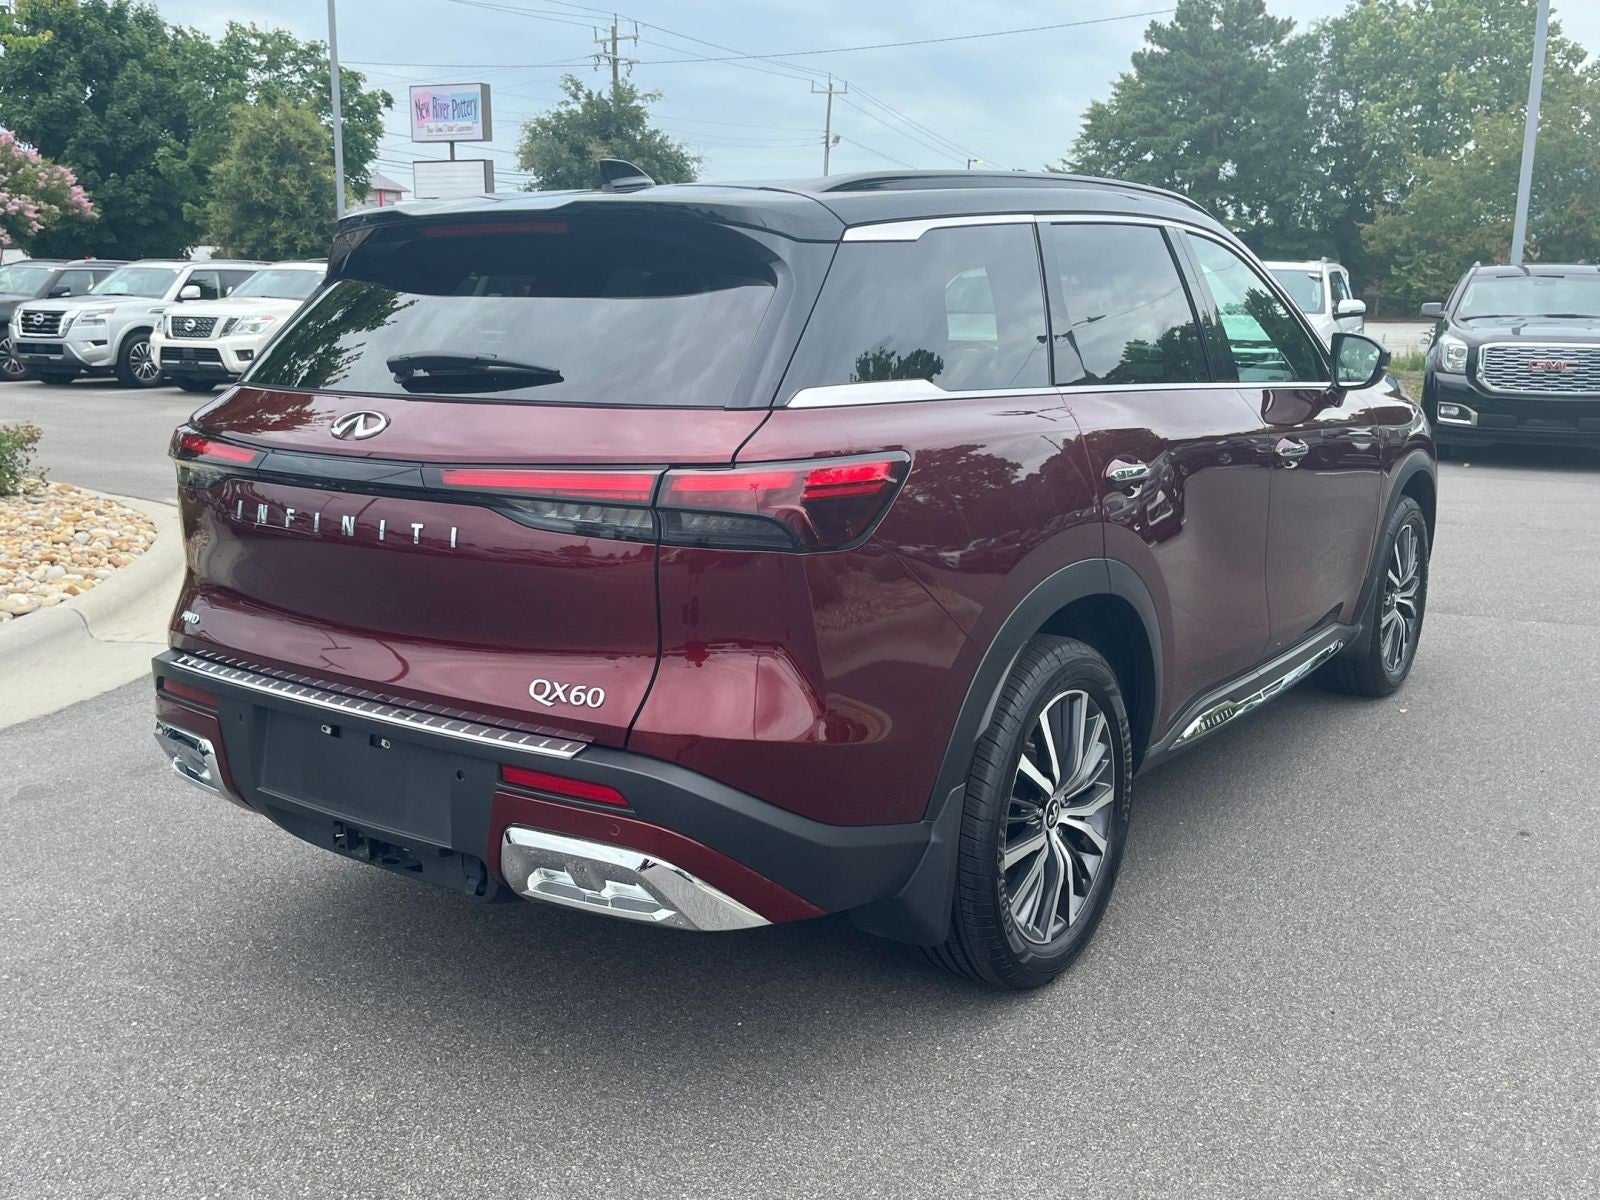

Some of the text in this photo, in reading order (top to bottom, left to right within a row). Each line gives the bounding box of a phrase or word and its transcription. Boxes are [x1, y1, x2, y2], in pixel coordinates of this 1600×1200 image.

[415, 97, 477, 120] New River Pottery
[1529, 359, 1579, 371] GMC
[236, 499, 458, 549] INFINITI
[528, 678, 606, 708] QX60
[1196, 708, 1233, 733] INFINITI
